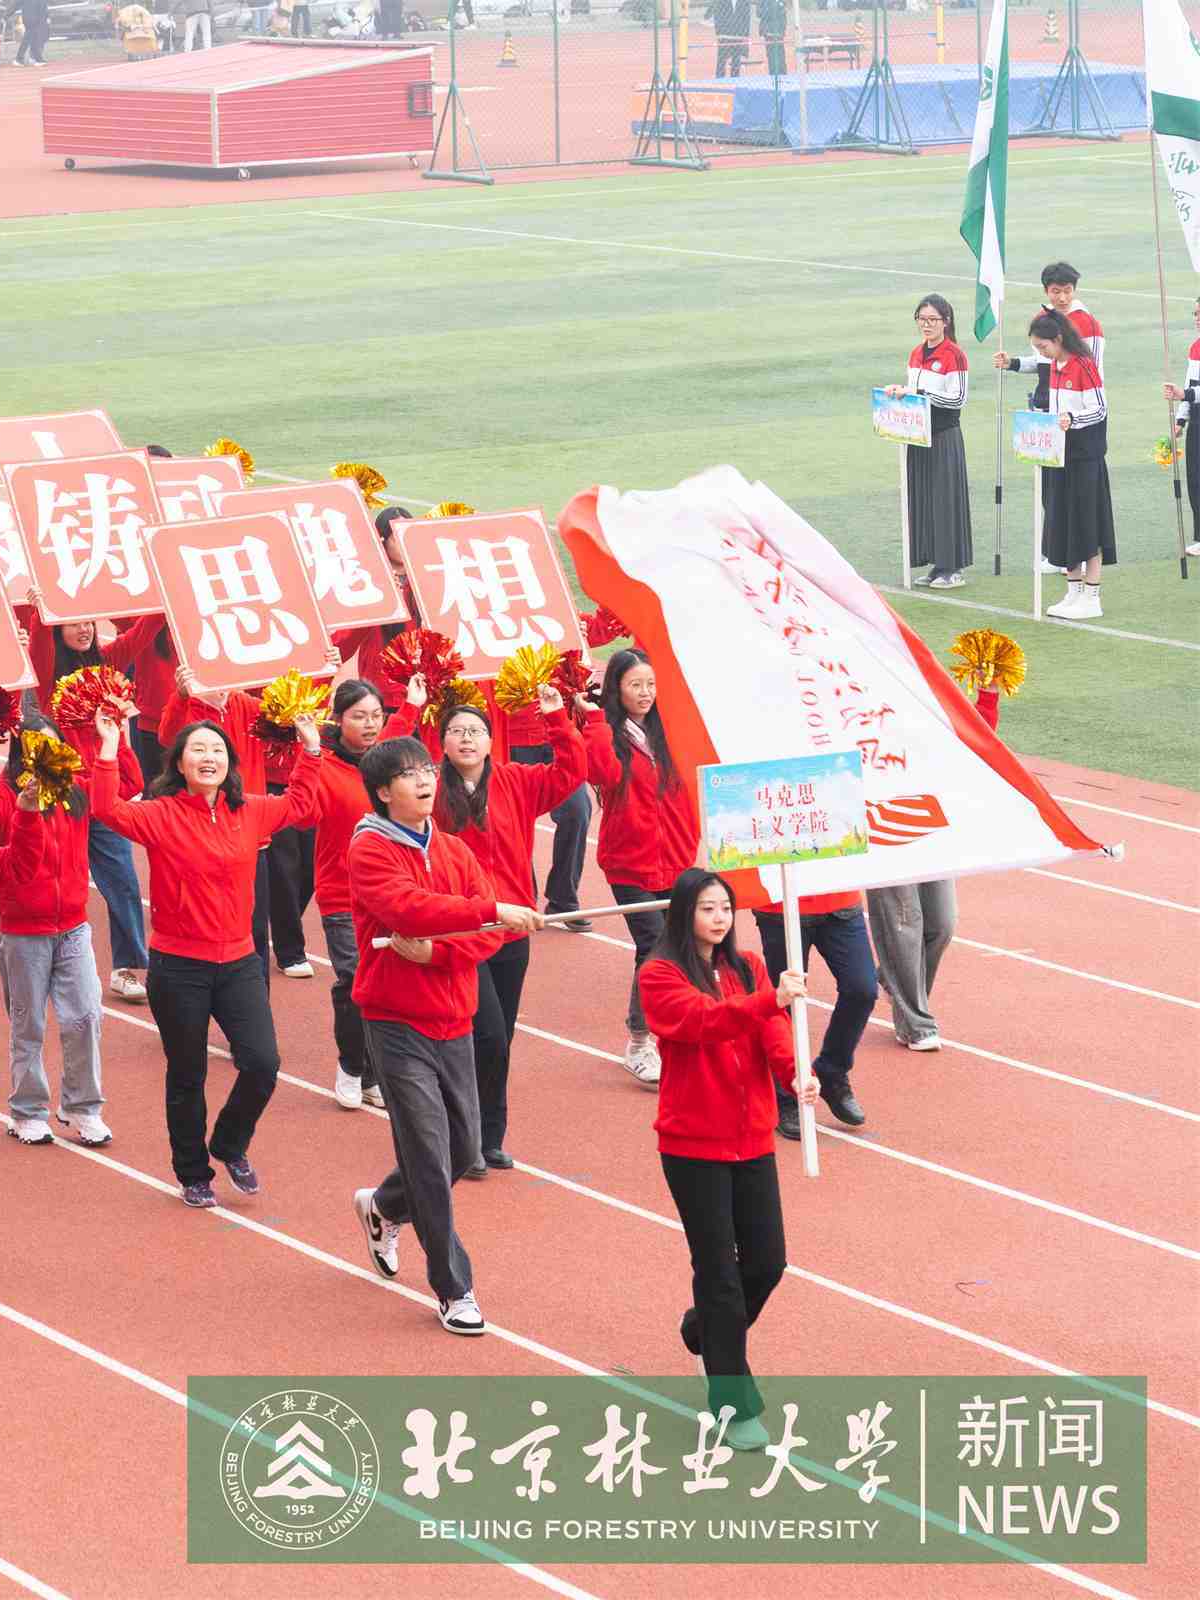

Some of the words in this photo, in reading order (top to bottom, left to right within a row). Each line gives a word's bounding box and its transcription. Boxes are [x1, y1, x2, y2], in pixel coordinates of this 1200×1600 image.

[34, 472, 151, 600] 铸
[423, 535, 566, 658] 想
[178, 535, 310, 665] 思
[751, 808, 830, 840] 主义学院
[756, 783, 816, 810] 马克思
